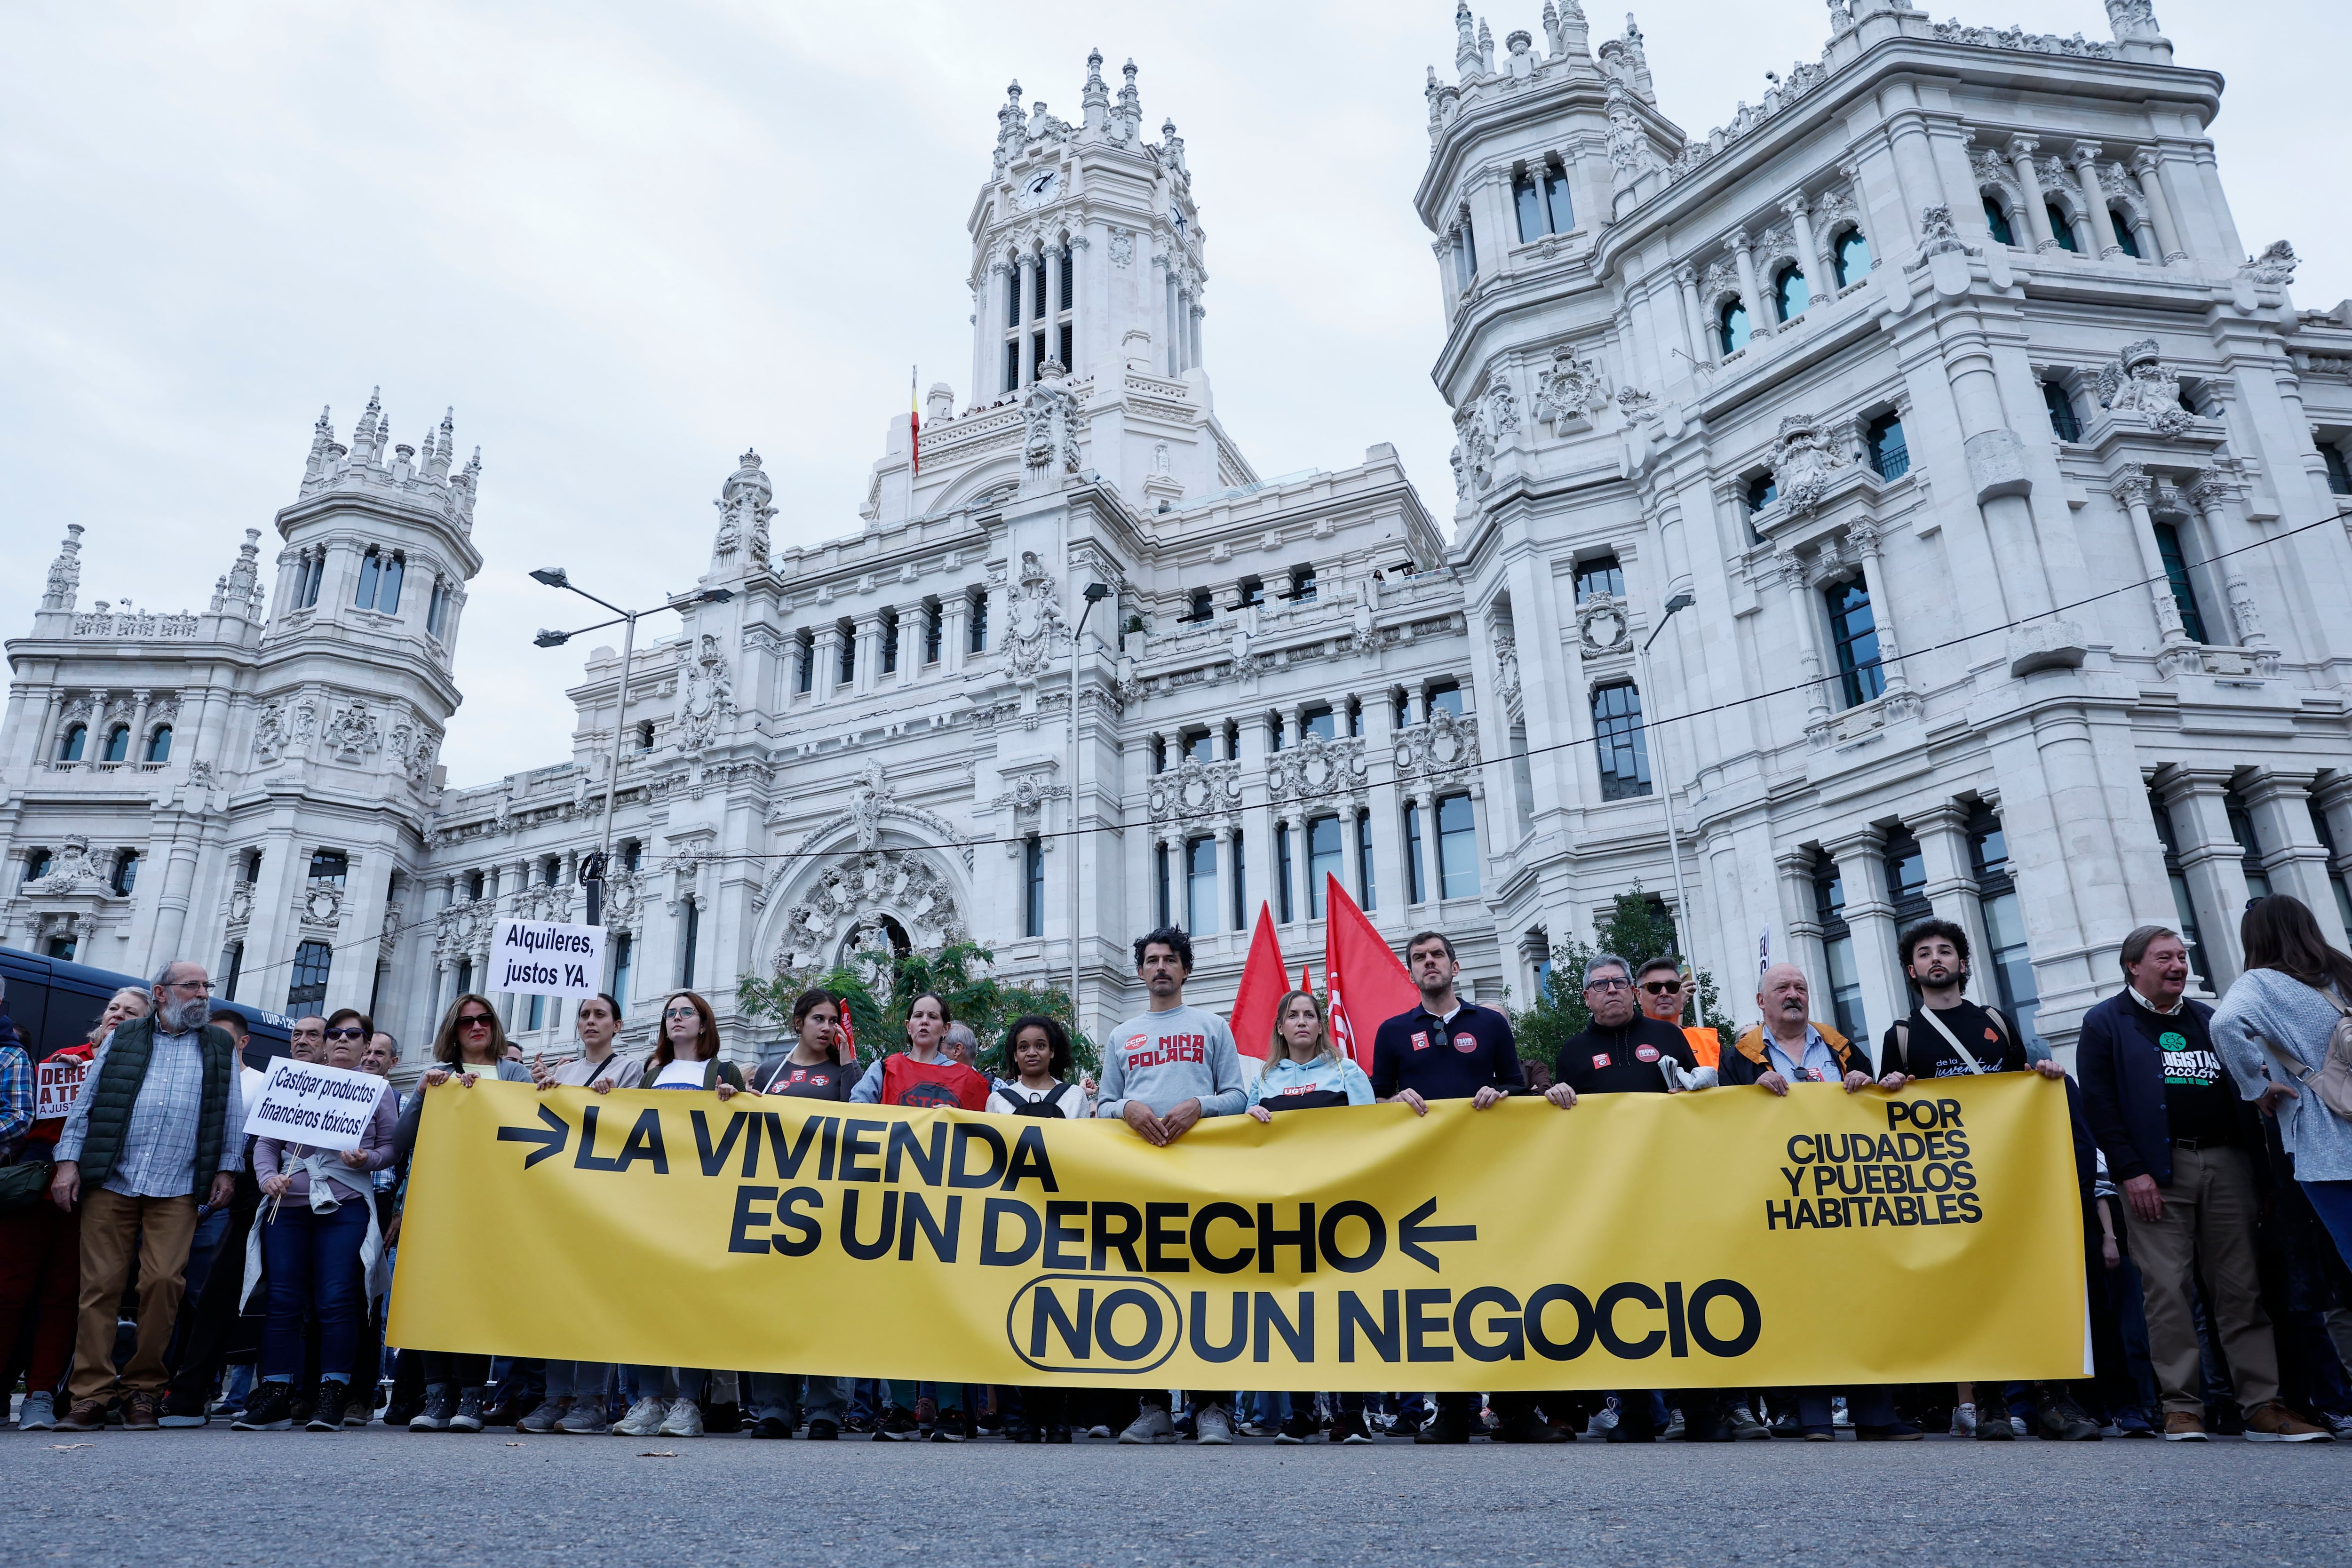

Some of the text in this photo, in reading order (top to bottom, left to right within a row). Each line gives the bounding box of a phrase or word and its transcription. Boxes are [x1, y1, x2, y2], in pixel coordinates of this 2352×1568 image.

[505, 924, 594, 957] Alquileres,
[503, 958, 588, 988] justos YA.
[1125, 1035, 1147, 1047] CCOO
[1159, 1032, 1204, 1051] NIÑA
[40, 1064, 91, 1085] DERE
[1128, 1047, 1204, 1071] POLACA
[2164, 1067, 2219, 1079] acción
[39, 1087, 53, 1105] A
[268, 1066, 376, 1103] ¡Castigar productos
[39, 1106, 47, 1114] A
[257, 1097, 366, 1136] financieros tóxicos!
[1886, 1098, 1964, 1131] POR
[573, 1106, 1060, 1193] LA VIVIENDA
[1787, 1129, 1970, 1165] CIUDADES
[1780, 1160, 1977, 1197] Y PUEBLOS
[1766, 1192, 1983, 1230] HABITABLES
[728, 1185, 1387, 1274] ES UN DERECHO
[1030, 1279, 1762, 1363] NO UN NEGOCIO
